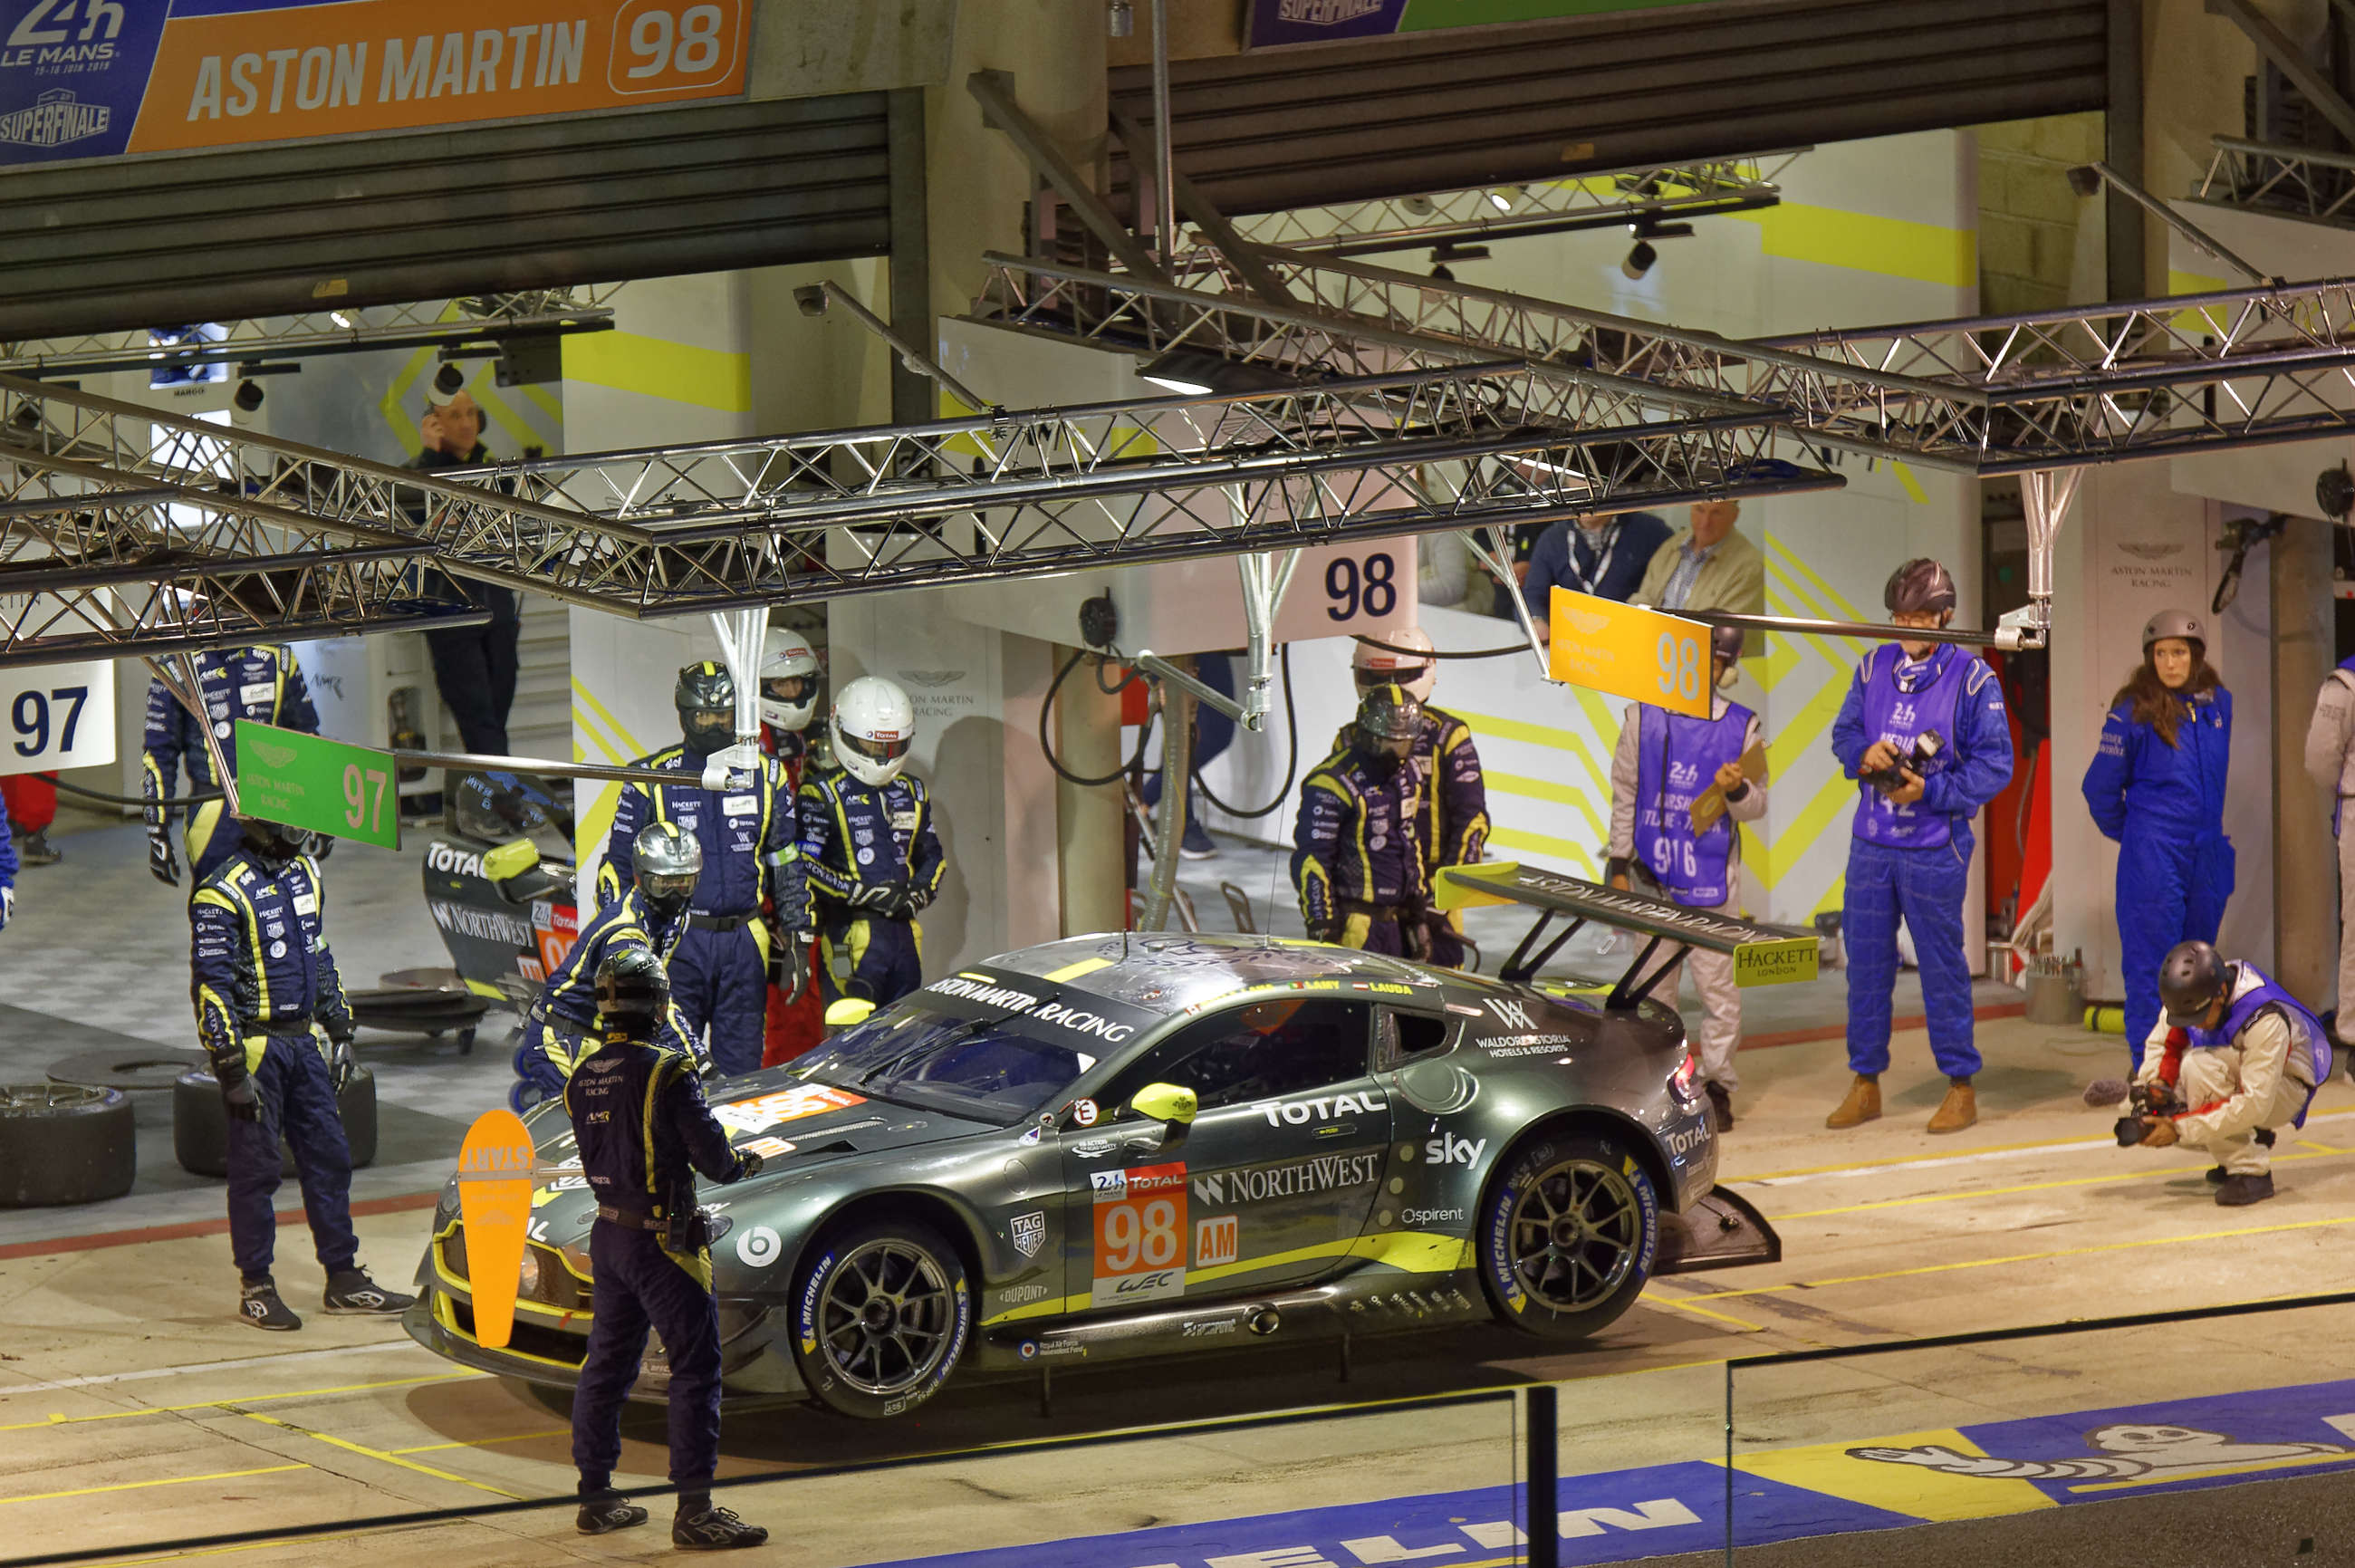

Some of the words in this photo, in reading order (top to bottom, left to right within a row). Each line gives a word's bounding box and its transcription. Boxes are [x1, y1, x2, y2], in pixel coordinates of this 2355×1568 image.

[0, 49, 35, 67] LE
[187, 42, 368, 122] ASTON
[377, 19, 588, 103] MARTIN
[626, 4, 723, 80] 98
[0, 104, 108, 144] SUPERFINALE
[1325, 553, 1397, 622] 98
[1657, 631, 1700, 700] 98
[930, 695, 974, 705] MARTIN
[11, 685, 89, 757] 97
[342, 763, 388, 833] 97
[1653, 836, 1697, 878] 916
[1737, 947, 1817, 970] HACKETT
[1757, 967, 1797, 977] LONDON
[1305, 980, 1340, 990] LAMY
[1369, 981, 1414, 996] LAUDA
[1033, 1002, 1135, 1043] RACING
[1489, 1048, 1524, 1058] HOTELS
[1252, 1091, 1388, 1128] TOTAL
[463, 1146, 529, 1170] START
[1425, 1131, 1486, 1170] sky
[1666, 1122, 1712, 1156] TOTAL
[1129, 1174, 1182, 1189] TOTAL
[1230, 1153, 1379, 1205] NORTHWEST
[1014, 1214, 1042, 1234] TAG
[1104, 1198, 1178, 1272] 98
[1414, 1207, 1465, 1227] spirent
[1638, 1185, 1656, 1272] MICHELIN
[1015, 1231, 1043, 1255] HEUER
[1198, 1221, 1235, 1262] AM
[1494, 1196, 1513, 1284] MICHELIN
[803, 1255, 831, 1325] MICHELIN
[1004, 1284, 1043, 1303] DUPONT
[942, 1306, 969, 1376] MICHELIN
